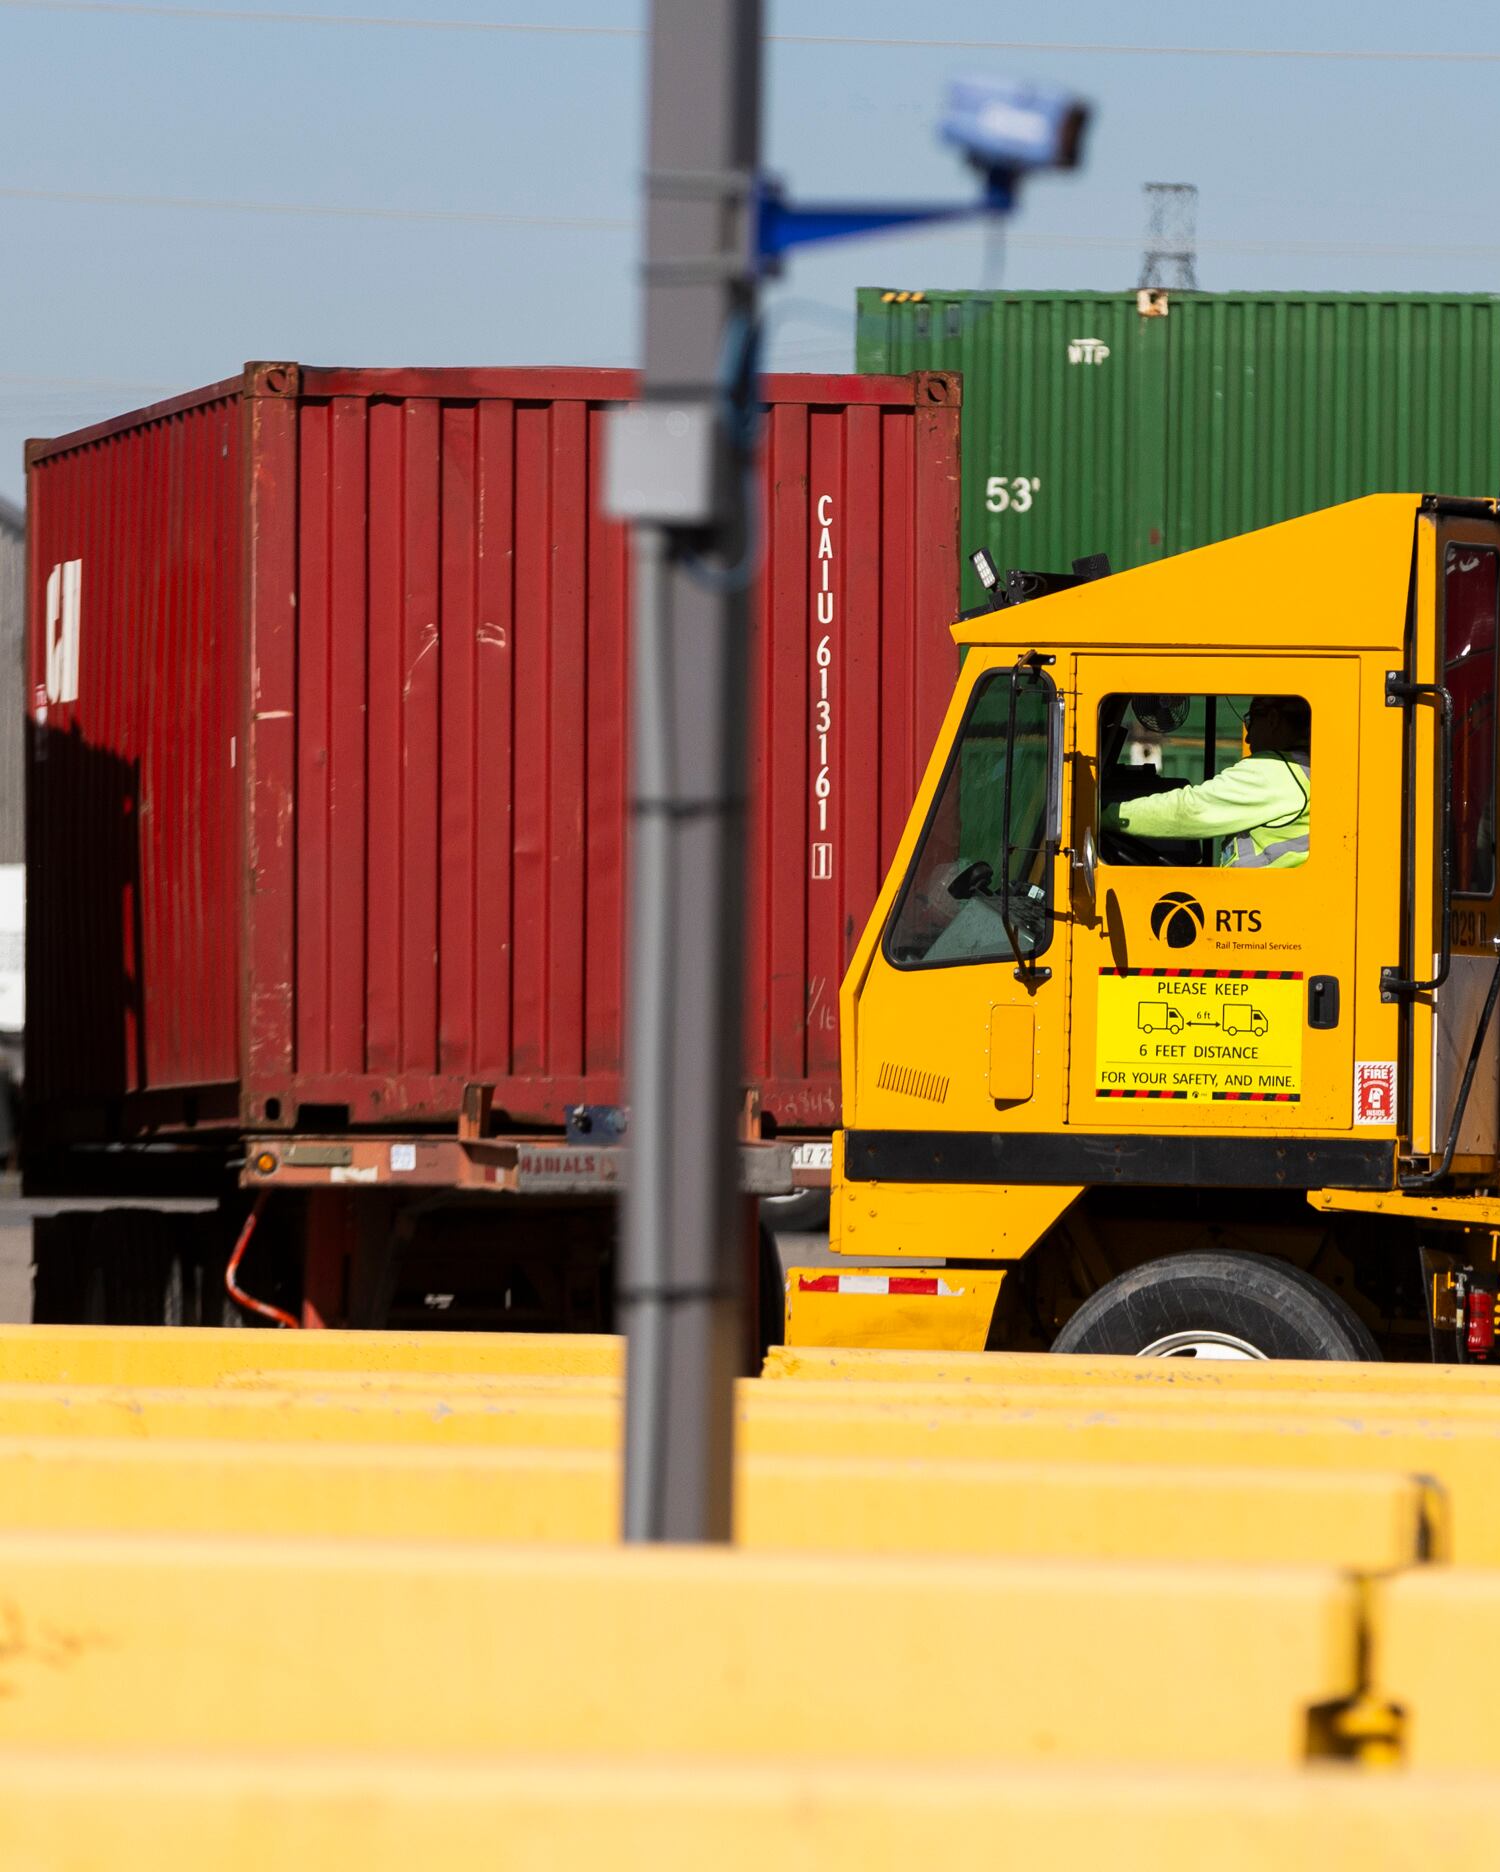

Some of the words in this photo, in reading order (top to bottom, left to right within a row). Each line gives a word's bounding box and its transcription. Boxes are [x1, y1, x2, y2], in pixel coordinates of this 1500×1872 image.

[986, 476, 1041, 513] 53'
[817, 494, 834, 625] CAIU
[815, 635, 832, 832] 613161
[1215, 909, 1262, 933] RTS
[1215, 941, 1231, 950] Rail
[1232, 941, 1267, 951] Terminal
[1268, 942, 1302, 952] Services
[1157, 981, 1207, 995] PLEASE
[1215, 982, 1249, 996] KEEP
[1196, 1011, 1203, 1020] 6
[1204, 1010, 1211, 1020] ft
[1139, 1044, 1148, 1057] 6
[1155, 1044, 1186, 1058] FEET
[1194, 1045, 1259, 1060] DISTANCE
[1101, 1071, 1126, 1083] FOR
[1132, 1072, 1168, 1085] YOUR
[1173, 1073, 1219, 1087] SAFETY,
[1224, 1074, 1253, 1087] AND
[1258, 1075, 1296, 1088] MINE.
[1363, 1068, 1389, 1080] FIRE
